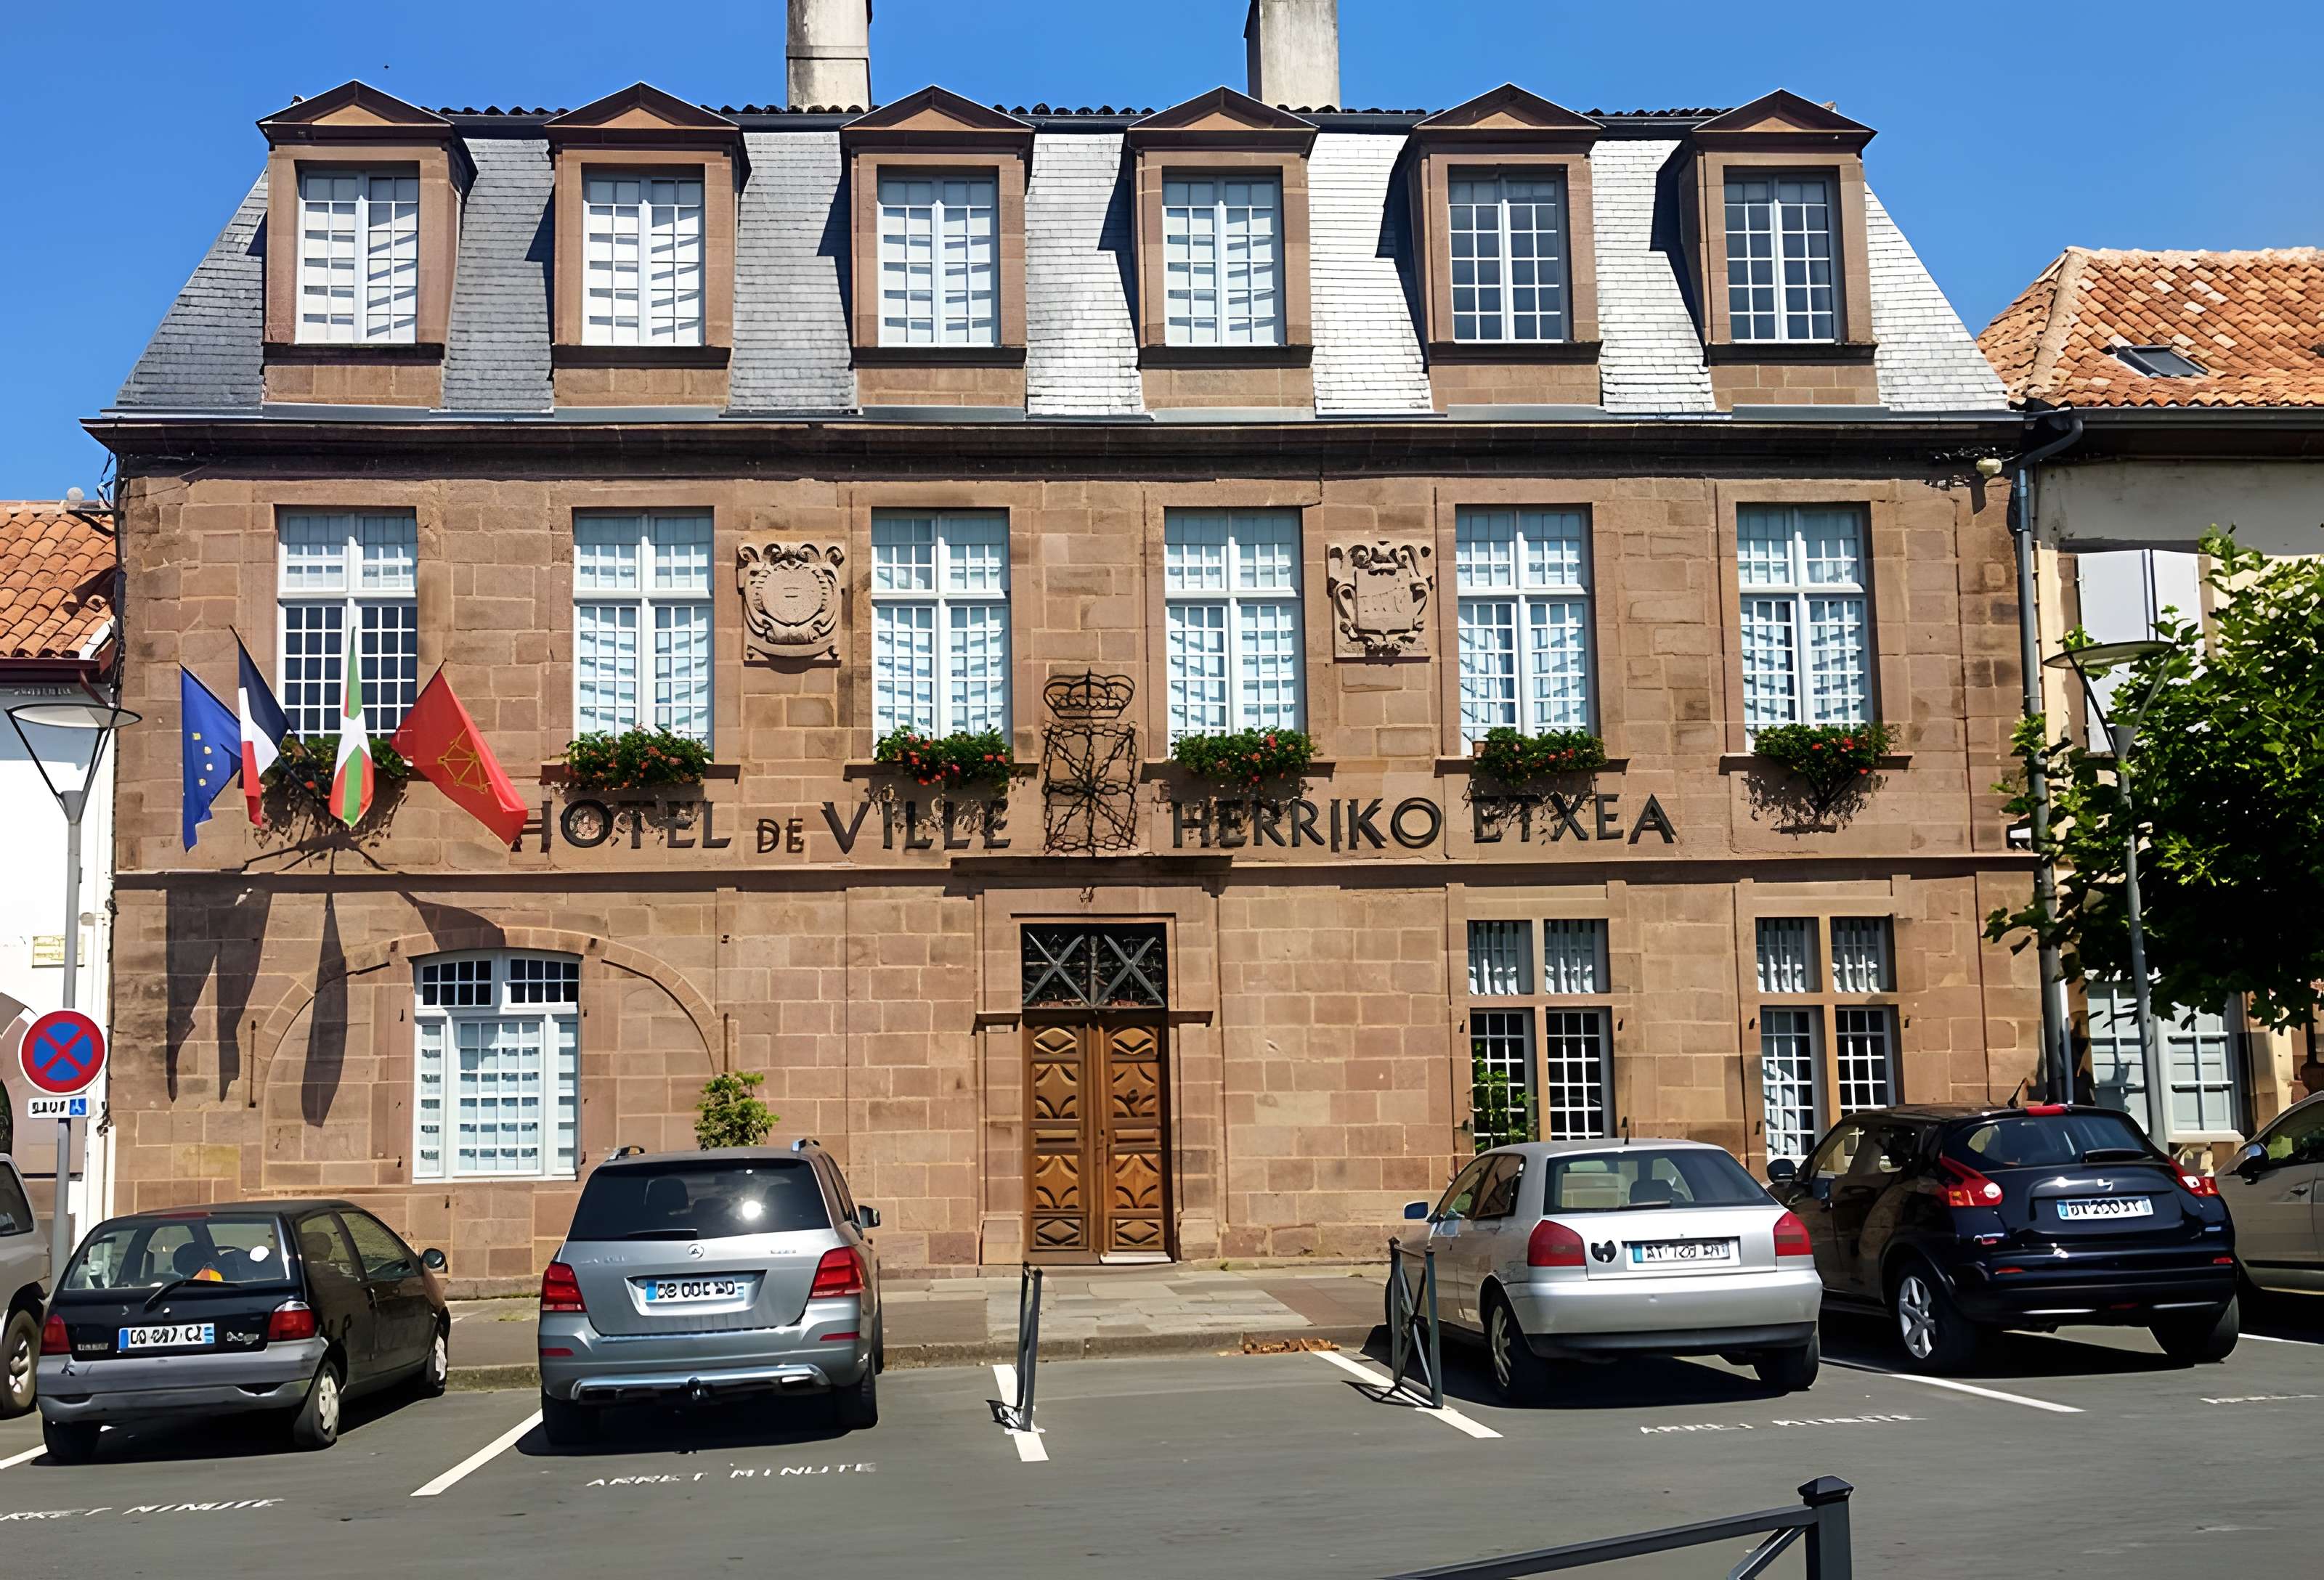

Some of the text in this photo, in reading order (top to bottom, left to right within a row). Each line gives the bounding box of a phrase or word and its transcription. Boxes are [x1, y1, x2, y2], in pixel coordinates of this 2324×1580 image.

[510, 799, 1013, 855] HOTEL DE VILLE
[1172, 792, 1676, 853] HERRIKO ETXEA
